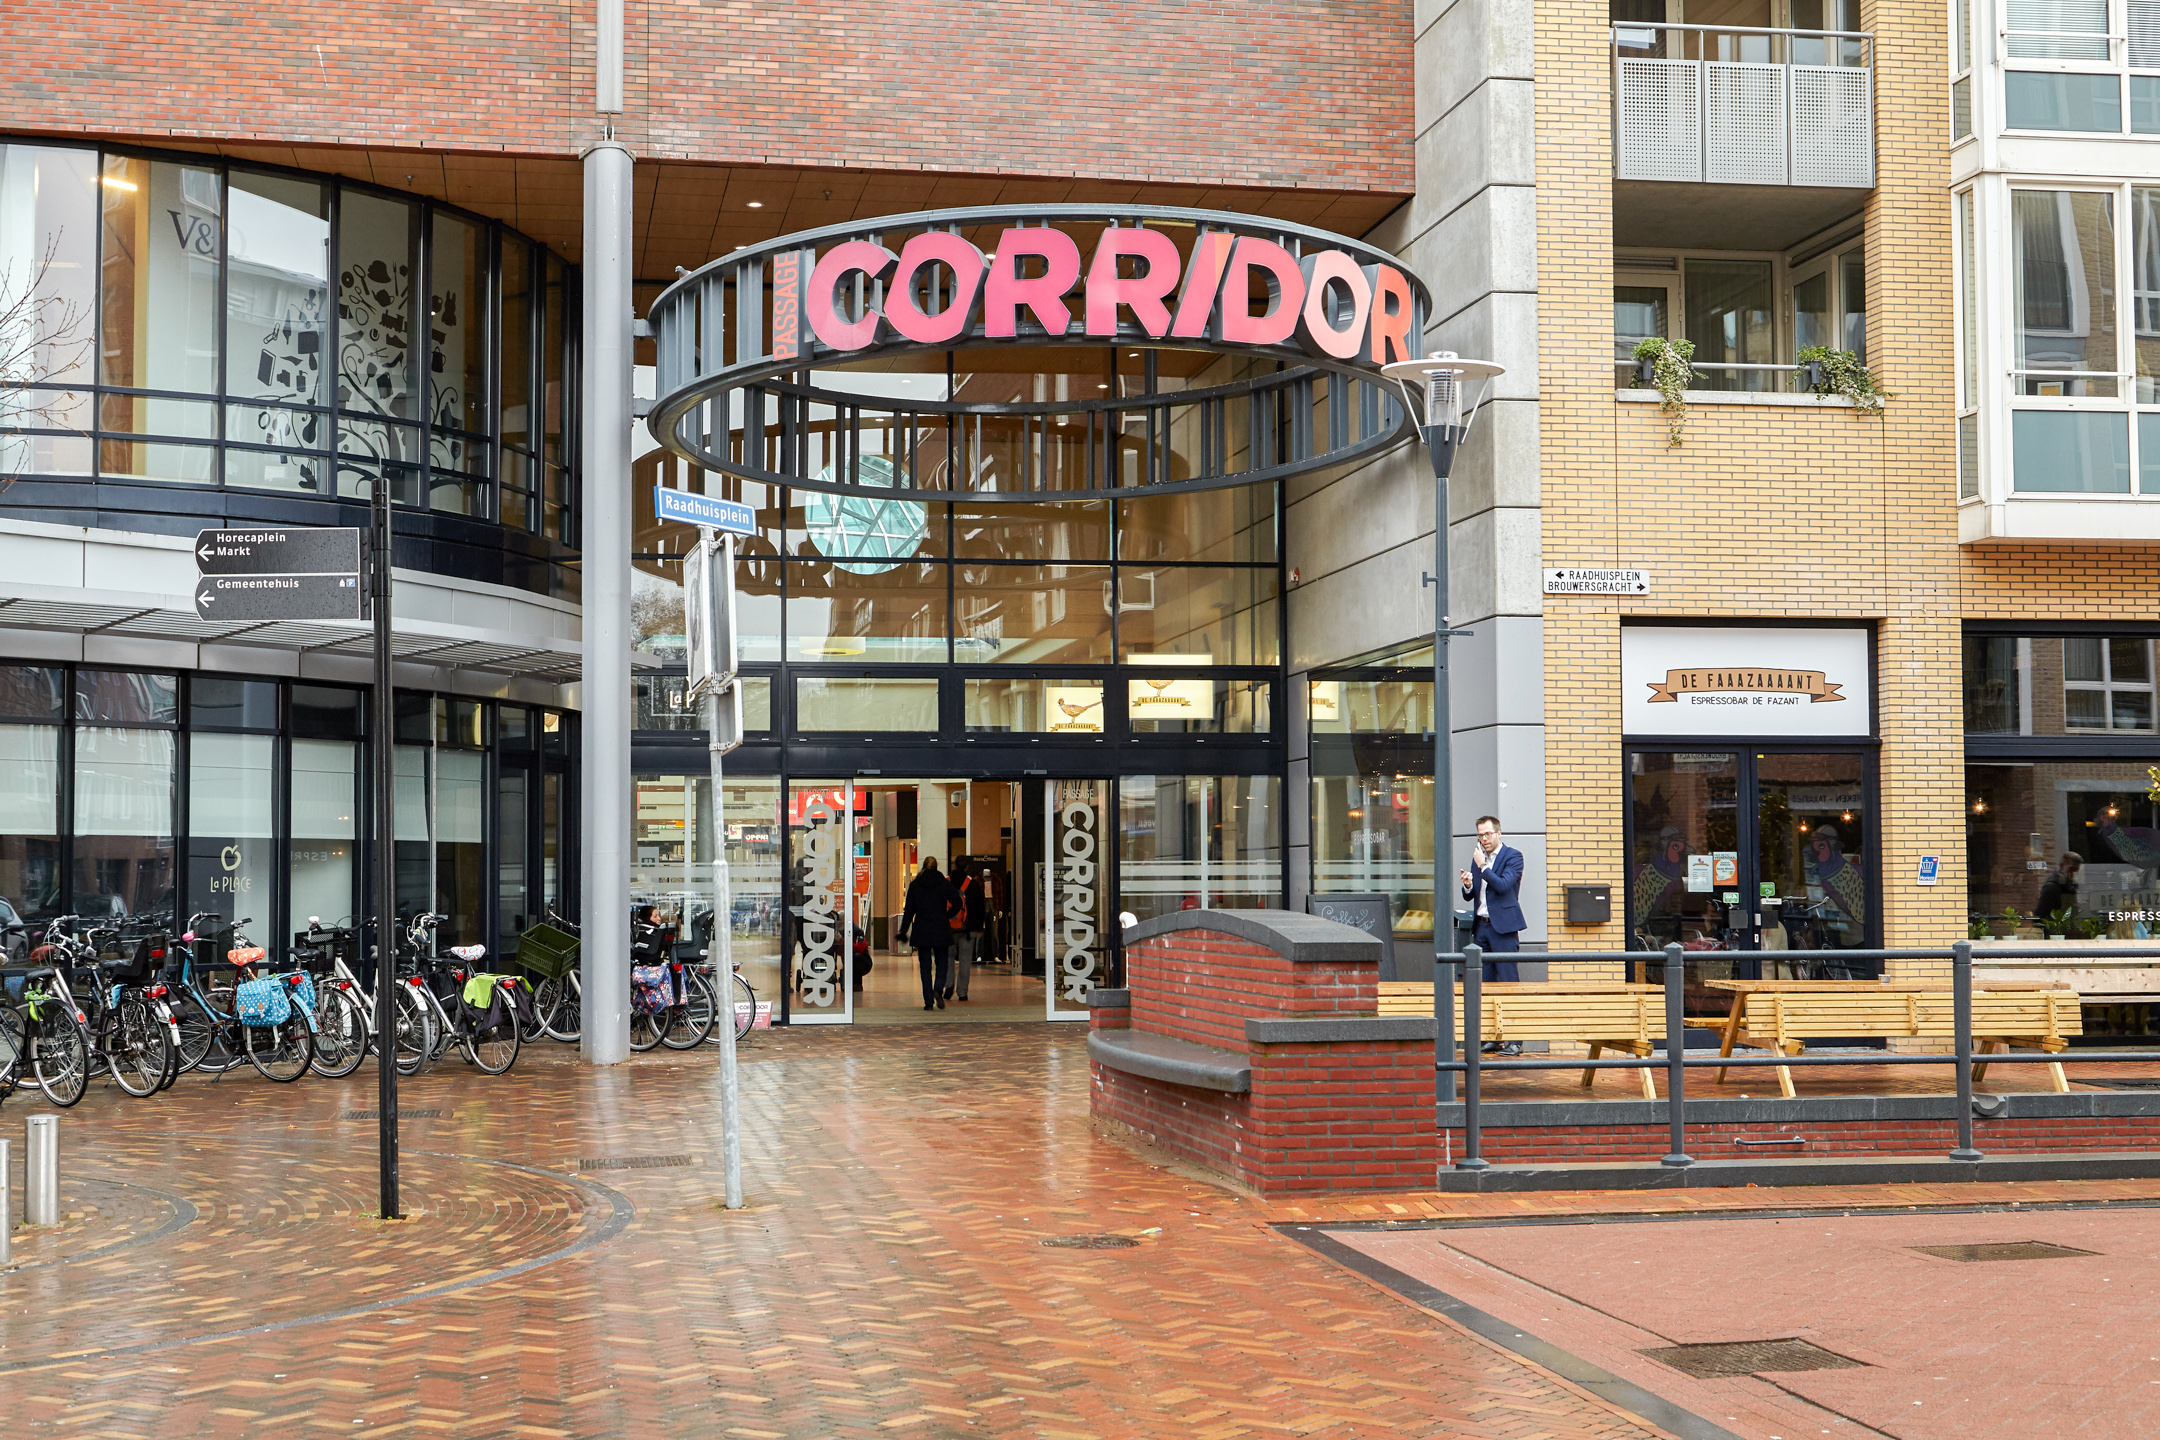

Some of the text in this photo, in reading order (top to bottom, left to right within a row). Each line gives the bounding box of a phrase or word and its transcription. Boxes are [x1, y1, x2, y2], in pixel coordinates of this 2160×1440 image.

[806, 226, 1412, 366] CORRIDOR
[773, 250, 799, 361] PASSAGE
[665, 494, 750, 525] Raadhuisplein
[216, 533, 286, 545] Horecaplein
[216, 546, 251, 556] Markt
[1569, 570, 1640, 581] RAADHUISPLEIN
[216, 579, 300, 589] Gemeentehuis
[1548, 581, 1632, 592] BROUWERSGRACHT
[1681, 673, 1813, 690] DE FAAAZAAAANT
[1691, 696, 1800, 706] ESPRESSOBAR DE FAZANT
[1063, 789, 1094, 799] PASSAGE
[210, 876, 252, 893] La PLACE
[803, 803, 836, 1008] CORRIDOR
[1062, 802, 1096, 1004] CORRIDOR
[2101, 894, 2115, 907] DE
